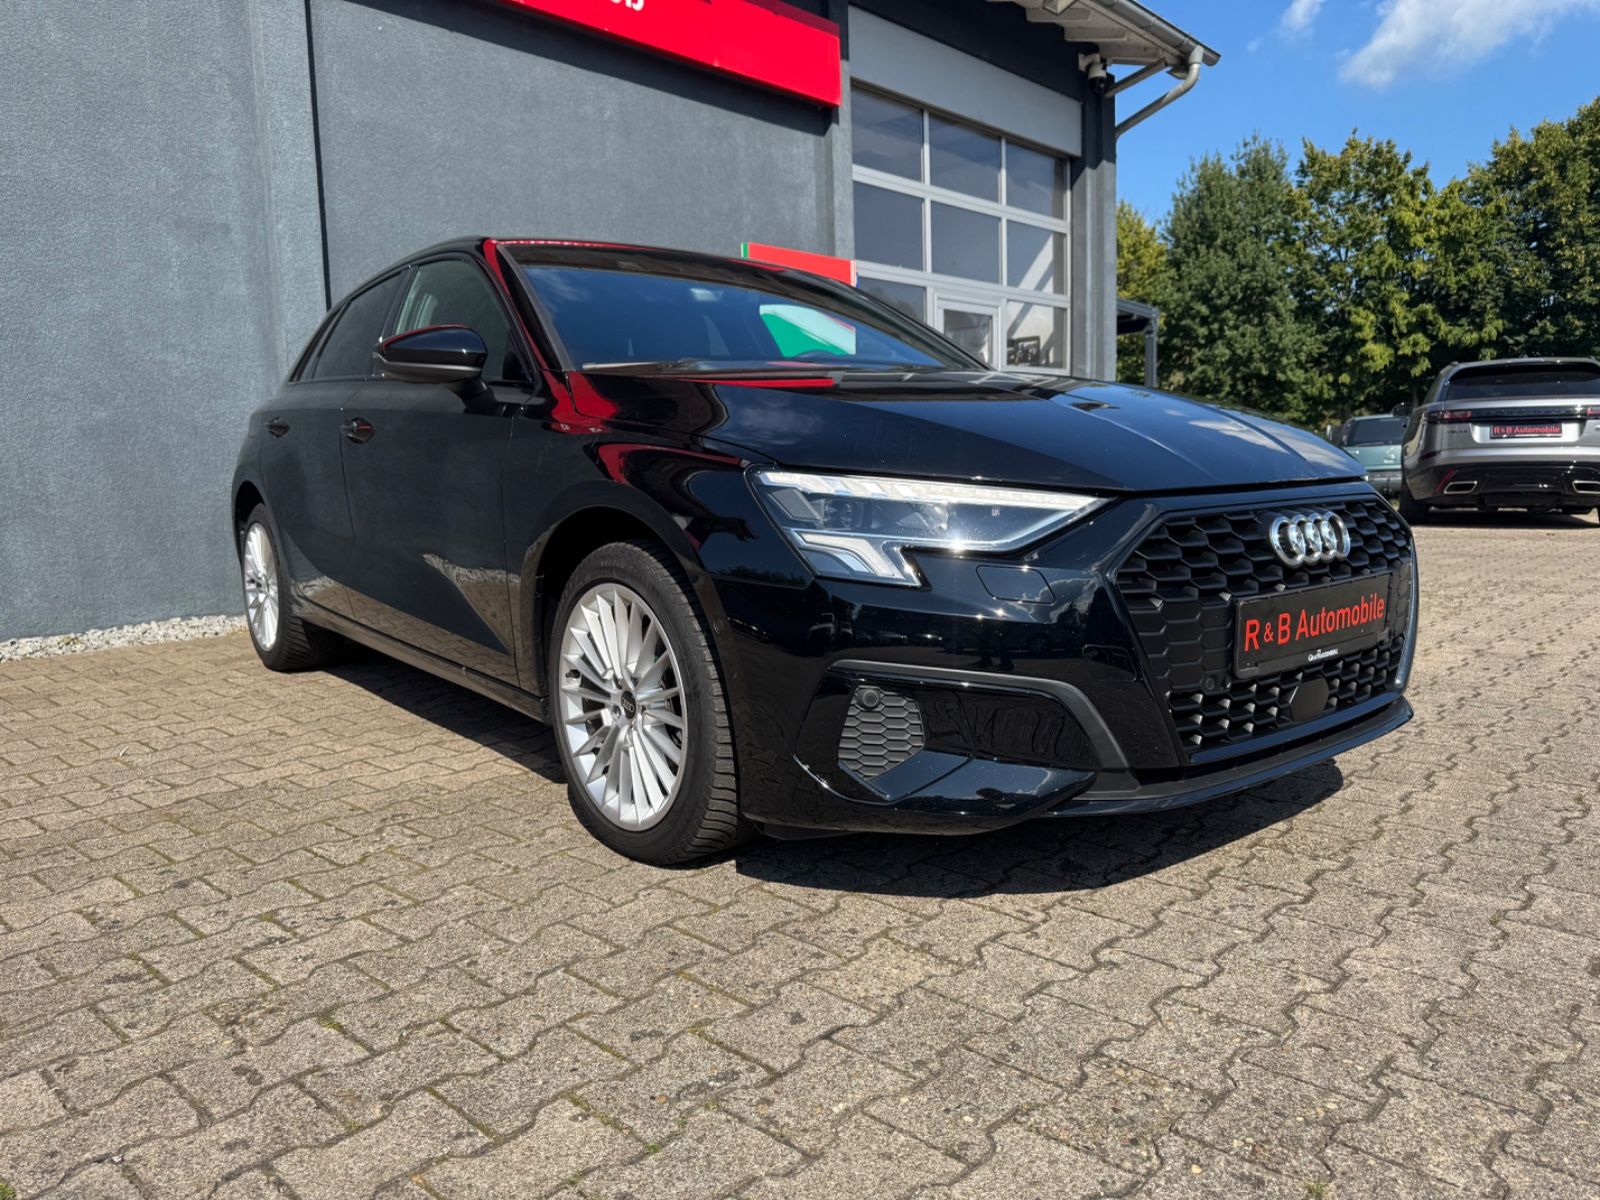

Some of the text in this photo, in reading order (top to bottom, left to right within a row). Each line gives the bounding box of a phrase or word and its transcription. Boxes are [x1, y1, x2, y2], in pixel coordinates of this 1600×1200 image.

[1514, 425, 1560, 433] Automobile
[1245, 593, 1385, 652] R & B Automobile
